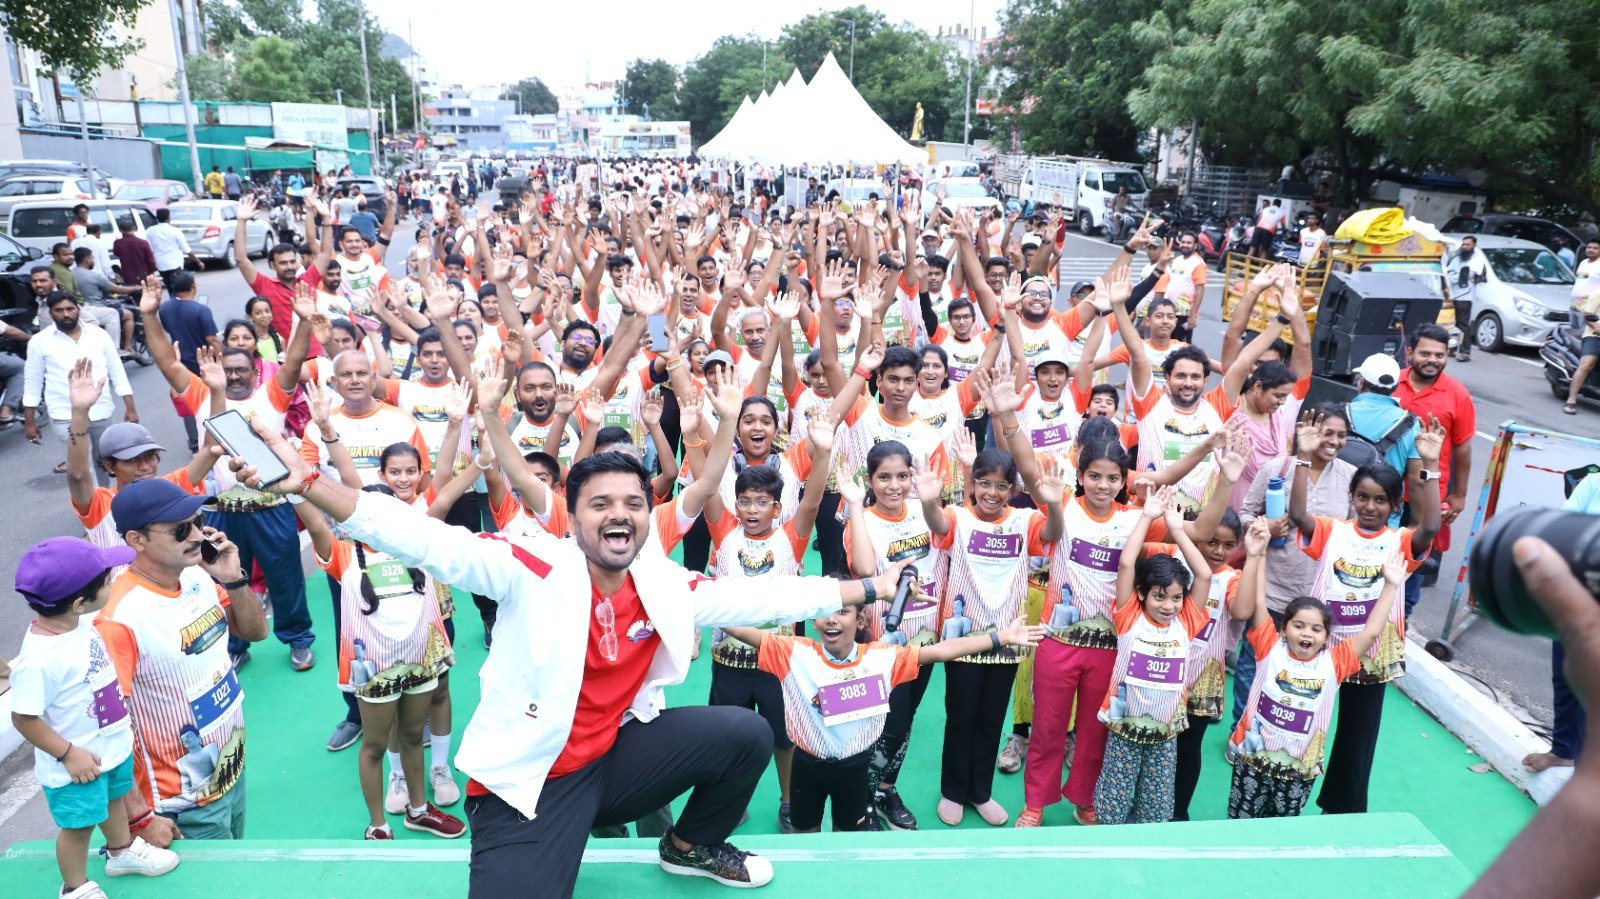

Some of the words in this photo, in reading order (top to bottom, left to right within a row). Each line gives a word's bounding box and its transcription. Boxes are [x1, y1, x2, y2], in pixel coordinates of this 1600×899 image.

[985, 536, 1007, 549] 3055
[1089, 548, 1111, 562] 3011
[382, 564, 404, 576] 5126
[1340, 605, 1366, 616] 3099
[1147, 660, 1170, 673] 3012
[211, 681, 231, 706] 1021
[839, 683, 867, 700] 3083
[1270, 704, 1295, 722] 3038
